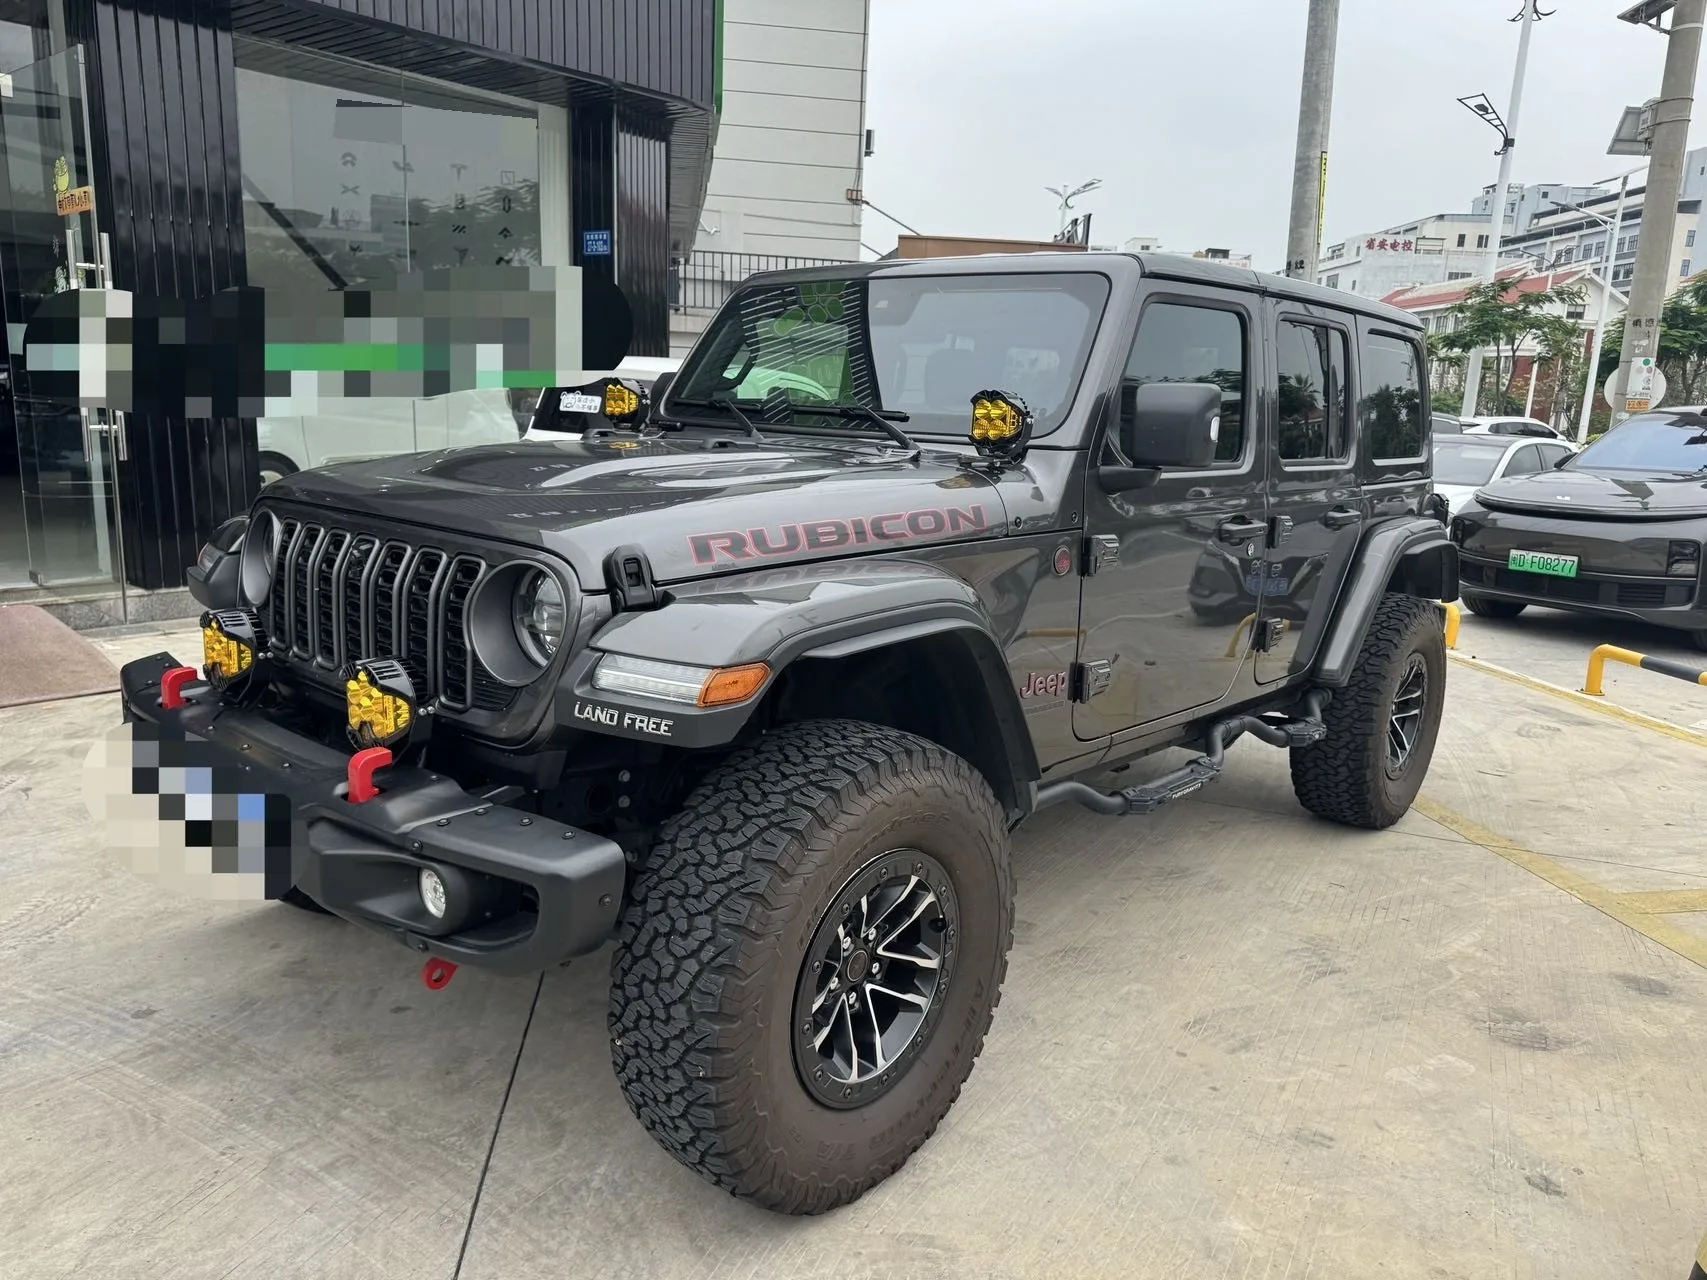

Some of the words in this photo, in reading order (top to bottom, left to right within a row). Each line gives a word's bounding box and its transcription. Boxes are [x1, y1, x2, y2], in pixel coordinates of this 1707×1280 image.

[1365, 237, 1414, 252] 省安电控
[687, 505, 988, 565] RUBICON
[1020, 671, 1067, 699] Jeep
[574, 701, 620, 727] LAND
[623, 712, 674, 737] FREE
